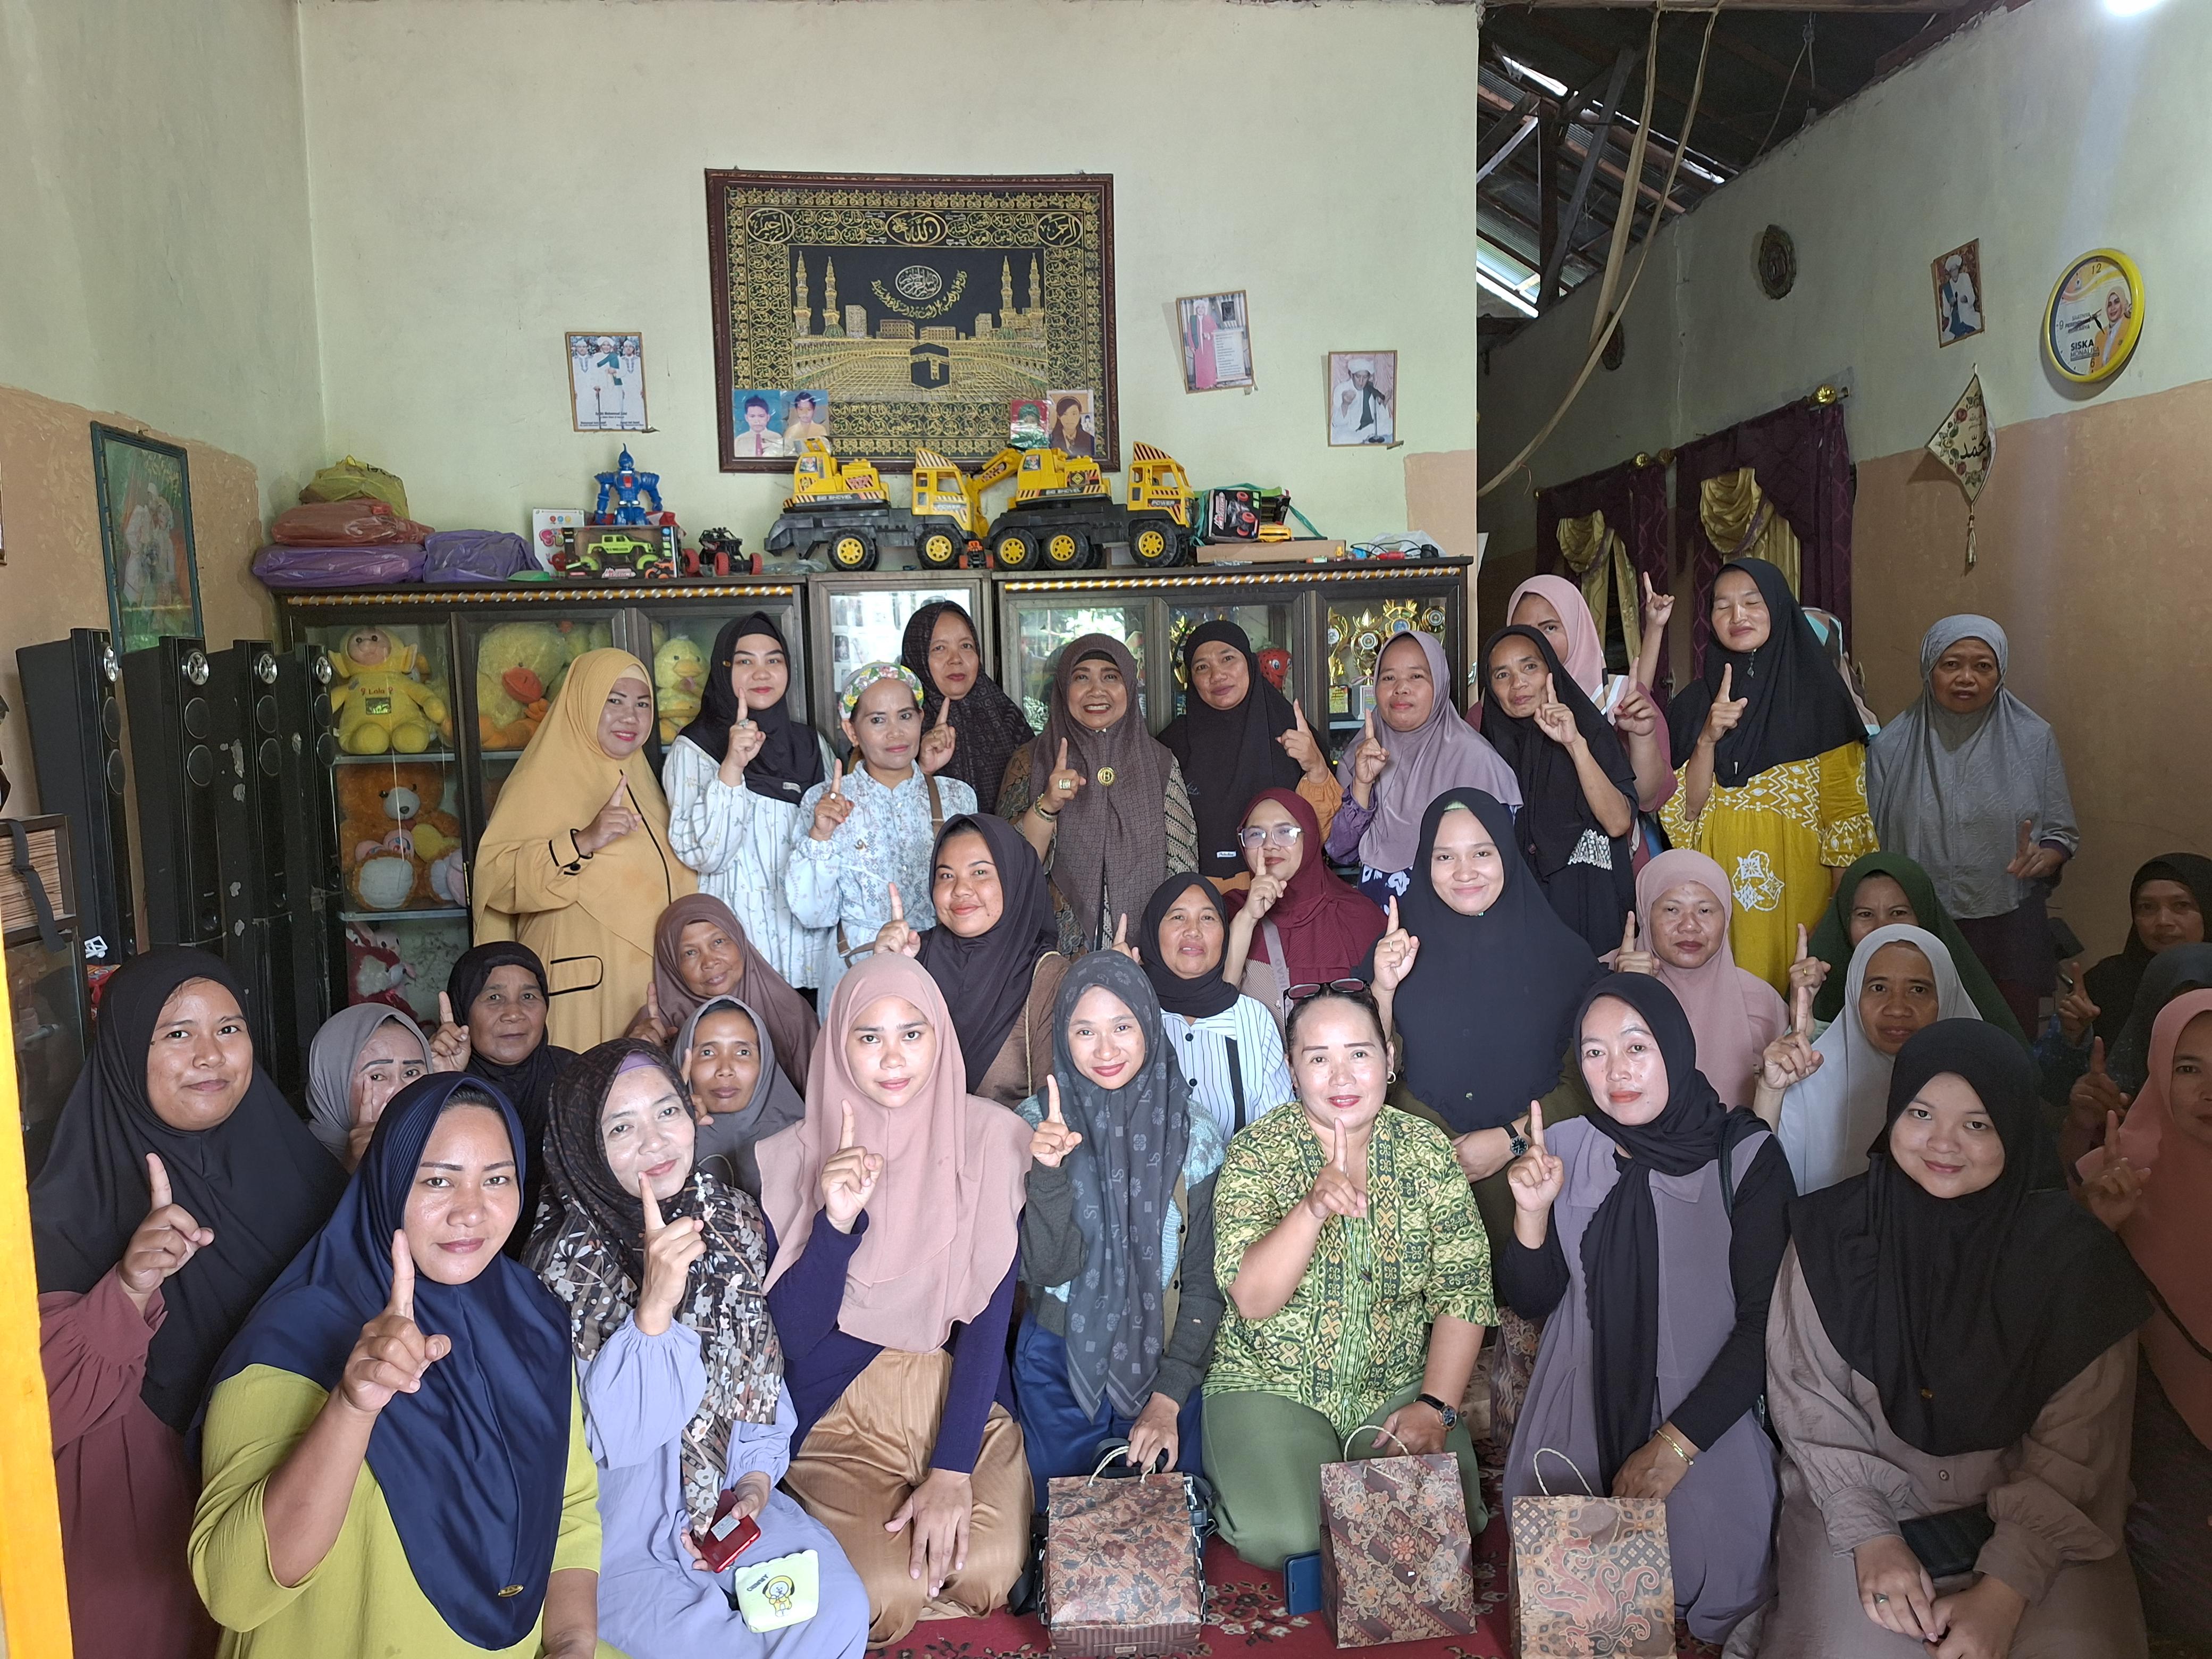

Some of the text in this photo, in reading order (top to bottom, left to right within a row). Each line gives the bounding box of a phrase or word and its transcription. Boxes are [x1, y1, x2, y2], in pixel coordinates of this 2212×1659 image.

[2092, 263, 2102, 275] 12
[2059, 320, 2063, 330] 9
[2071, 339, 2094, 351] SISKA
[2090, 357, 2095, 368] 6
